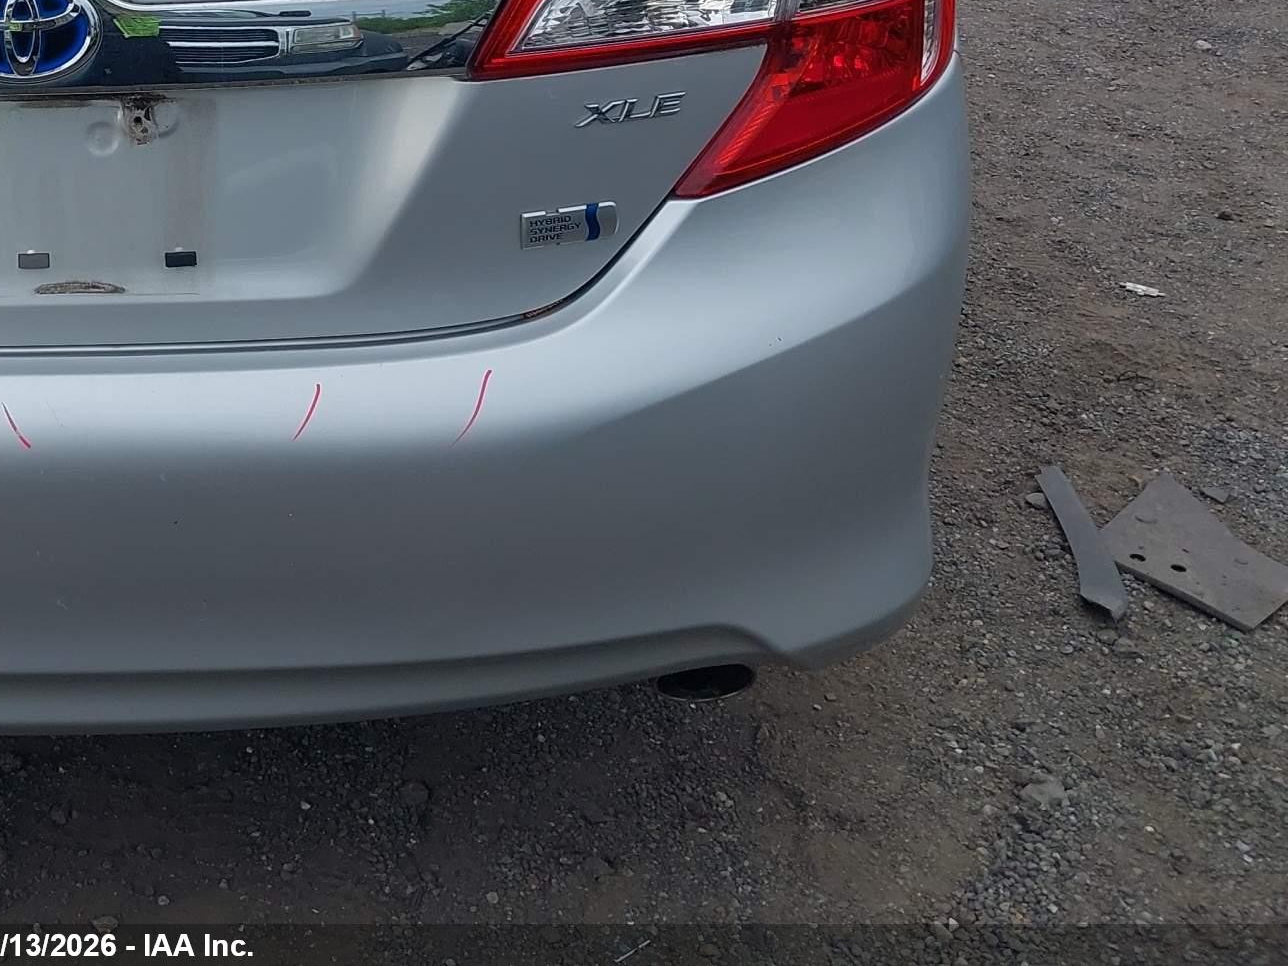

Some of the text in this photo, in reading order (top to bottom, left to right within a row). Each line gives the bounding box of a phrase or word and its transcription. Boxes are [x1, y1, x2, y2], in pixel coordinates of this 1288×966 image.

[575, 91, 686, 128] XLE
[529, 215, 572, 228] HYBRID
[529, 222, 582, 236] SYNERGY
[529, 233, 562, 243] DRIVE
